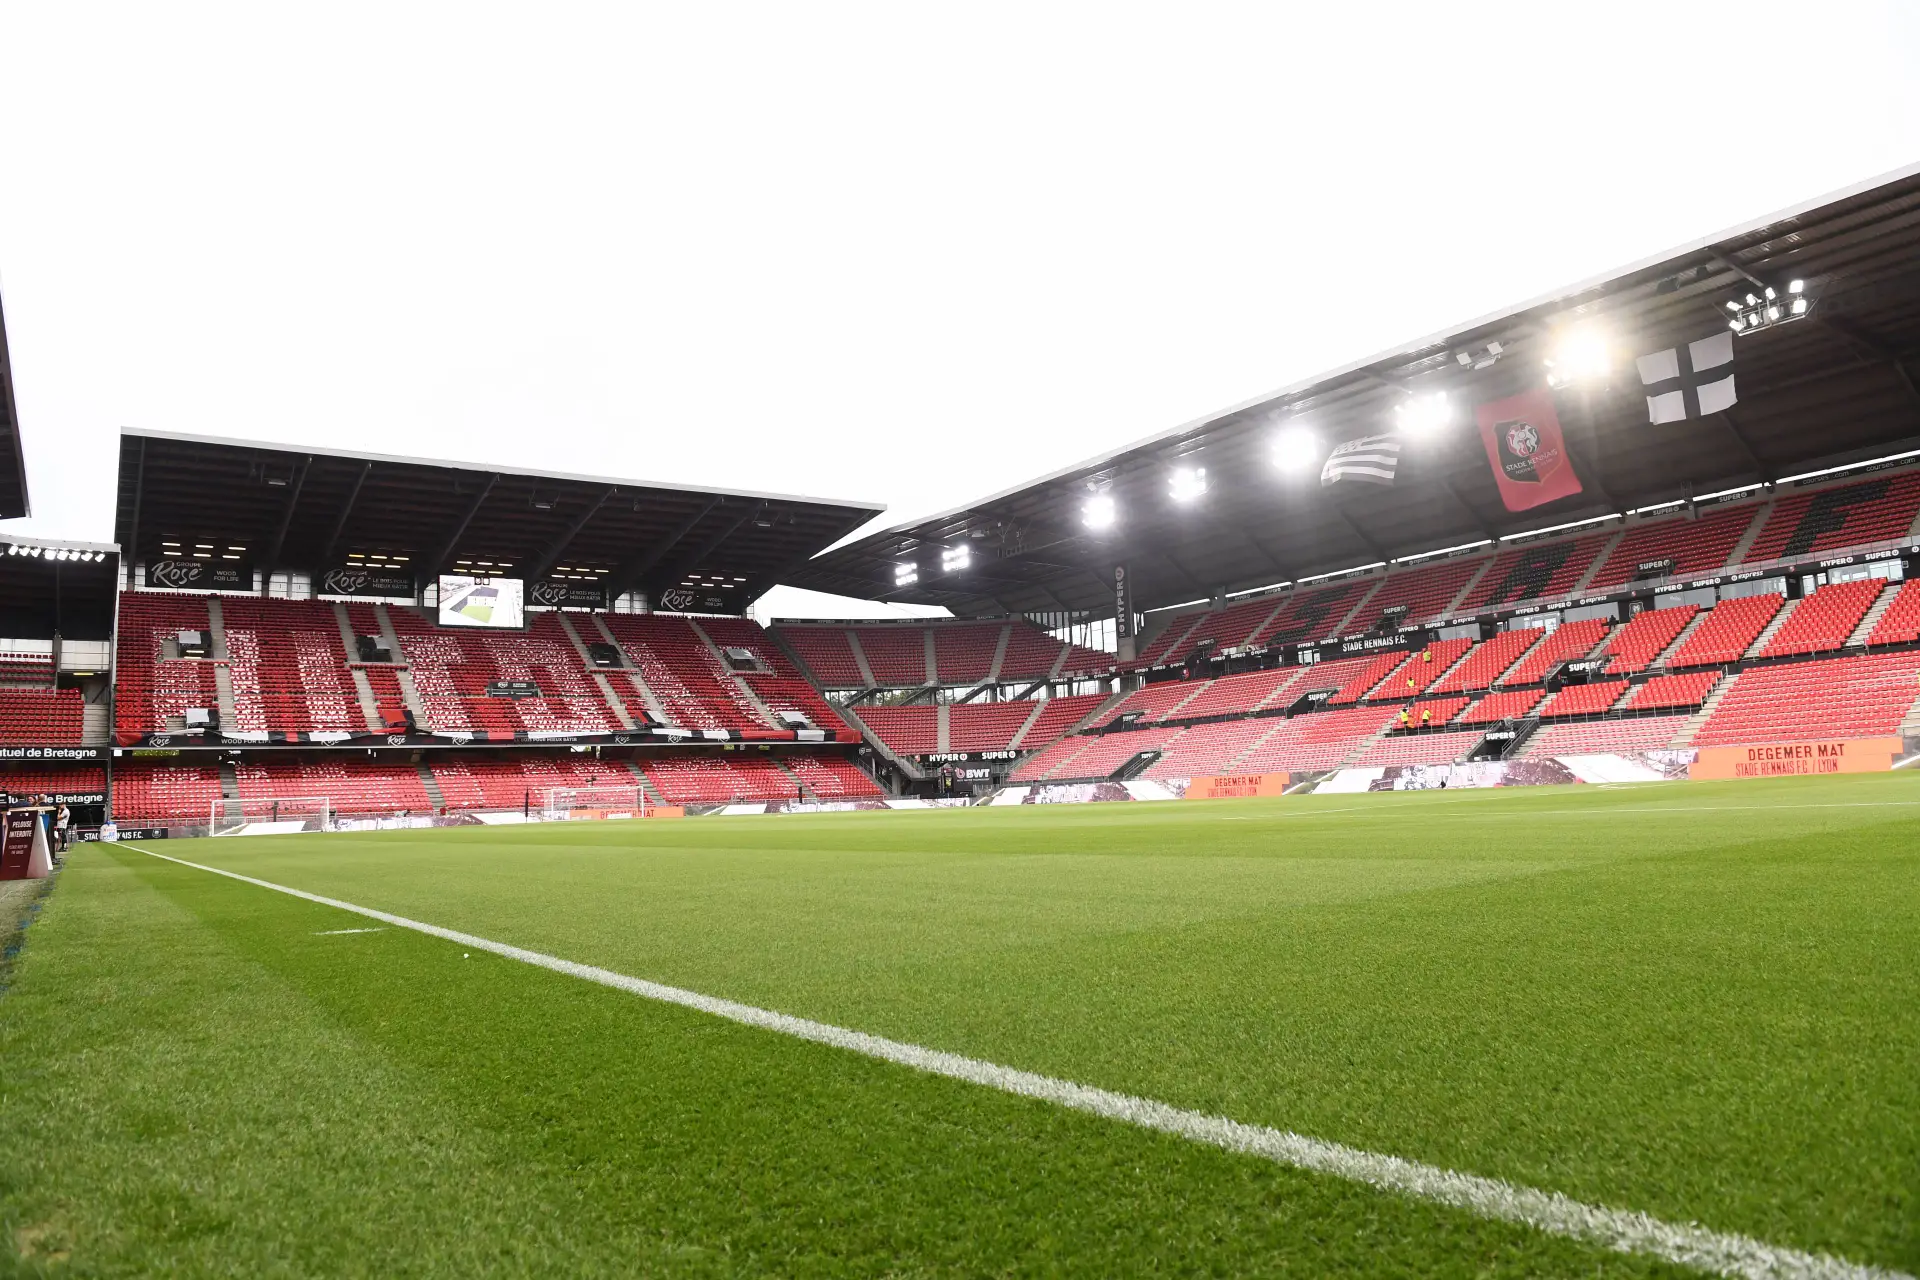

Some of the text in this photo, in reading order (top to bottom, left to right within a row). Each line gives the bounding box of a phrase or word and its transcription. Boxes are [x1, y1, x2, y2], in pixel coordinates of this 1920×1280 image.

[1505, 460, 1527, 471] STADE
[1866, 462, 1894, 472] courses
[1719, 493, 1740, 502] SUPER
[1653, 507, 1673, 516] SUPER
[1865, 550, 1891, 560] SUPER
[1639, 561, 1663, 570] SUPER
[1821, 558, 1846, 567] HYPER
[151, 561, 202, 587] Rose
[324, 569, 368, 594] Rose
[1655, 584, 1676, 593] HYPER
[1692, 579, 1714, 588] SUPER
[1738, 570, 1763, 580] express
[530, 581, 569, 605] Rose
[660, 589, 694, 611] Rose
[1116, 581, 1125, 623] HYPER
[1586, 595, 1607, 604] express
[1343, 635, 1407, 652] STADE RENNAIS F.C.
[1568, 662, 1596, 672] SUPER
[149, 735, 171, 747] Rose
[387, 735, 406, 746] Rose
[1486, 732, 1508, 740] SUPER
[0, 748, 97, 759] tuel de Bretagne
[1748, 744, 1845, 760] DEGEMER MAT
[929, 754, 958, 762] HYPER
[1736, 763, 1758, 777] STADE
[1761, 761, 1794, 775] RENNAIS
[1818, 759, 1838, 772] LYON
[966, 769, 990, 778] BWT
[1215, 776, 1262, 786] DEGEMER MAT
[55, 795, 103, 804] Bretagne
